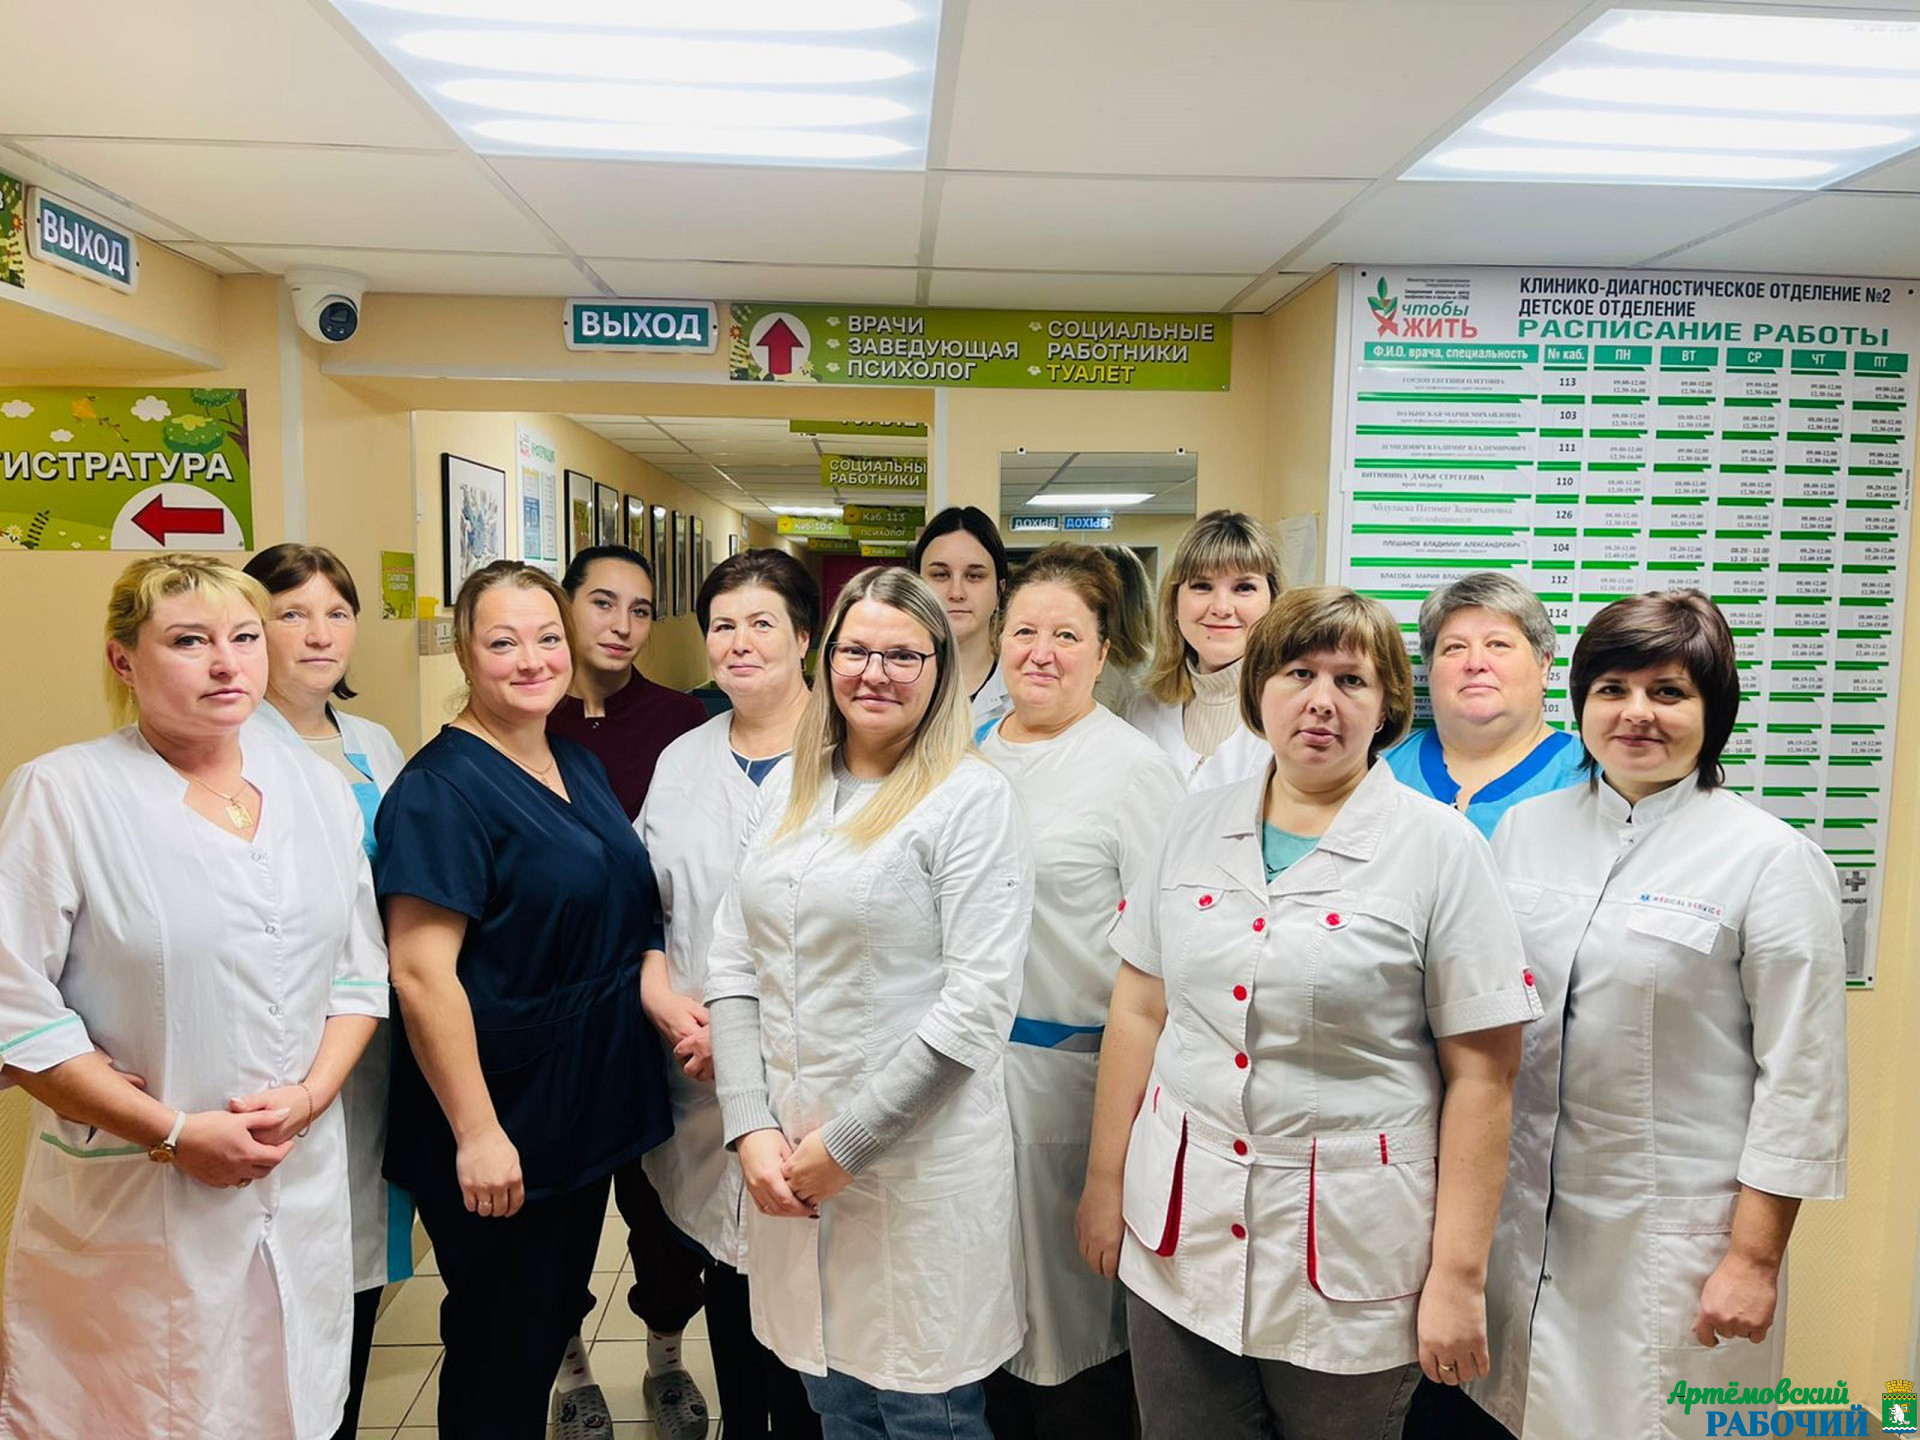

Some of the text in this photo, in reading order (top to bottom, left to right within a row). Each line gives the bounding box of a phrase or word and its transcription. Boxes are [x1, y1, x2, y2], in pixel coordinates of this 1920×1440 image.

[43, 208, 125, 276] ВЫХОД
[1519, 277, 1891, 303] КЛИНИКО-ДИАГНОСТИЧЕСКОЕ ОТДЕЛЕНИЕ №2
[1401, 301, 1470, 316] чтобы
[1518, 298, 1696, 318] ДЕТСКОЕ ОТДЕЛЕНИЕ
[581, 310, 702, 341] ВЫХОД
[847, 315, 925, 335] ВРАЧИ
[1047, 319, 1214, 343] СОЦИАЛЬНЫЕ
[1402, 318, 1478, 338] ЖИТЬ
[1518, 319, 1889, 346] РАСПИСАНИЕ РАБОТЫ
[847, 338, 1019, 361] ЗАВЕДУЮЩАЯ
[1047, 343, 1189, 363] РАБОТНИКИ
[1445, 348, 1529, 360] специальность
[1563, 348, 1585, 360] каб.
[1615, 349, 1631, 361] ПН
[1681, 350, 1697, 361] ВТ
[1747, 351, 1763, 363] СР
[1811, 353, 1826, 365] ЧТ
[1873, 356, 1888, 367] ПТ
[847, 359, 978, 380] ПСИХОЛОГ
[1046, 363, 1136, 383] ТУАЛЕТ
[1559, 378, 1576, 386] 113
[1560, 411, 1577, 420] 103
[0, 450, 234, 481] ИСТРАТУРА
[829, 473, 920, 486] РАБОТНИКИ
[1556, 477, 1573, 486] 110
[1556, 510, 1573, 519] 126
[1553, 543, 1569, 552] 104
[1551, 575, 1568, 584] 112
[1549, 608, 1568, 618] 114
[1543, 704, 1559, 712] 101
